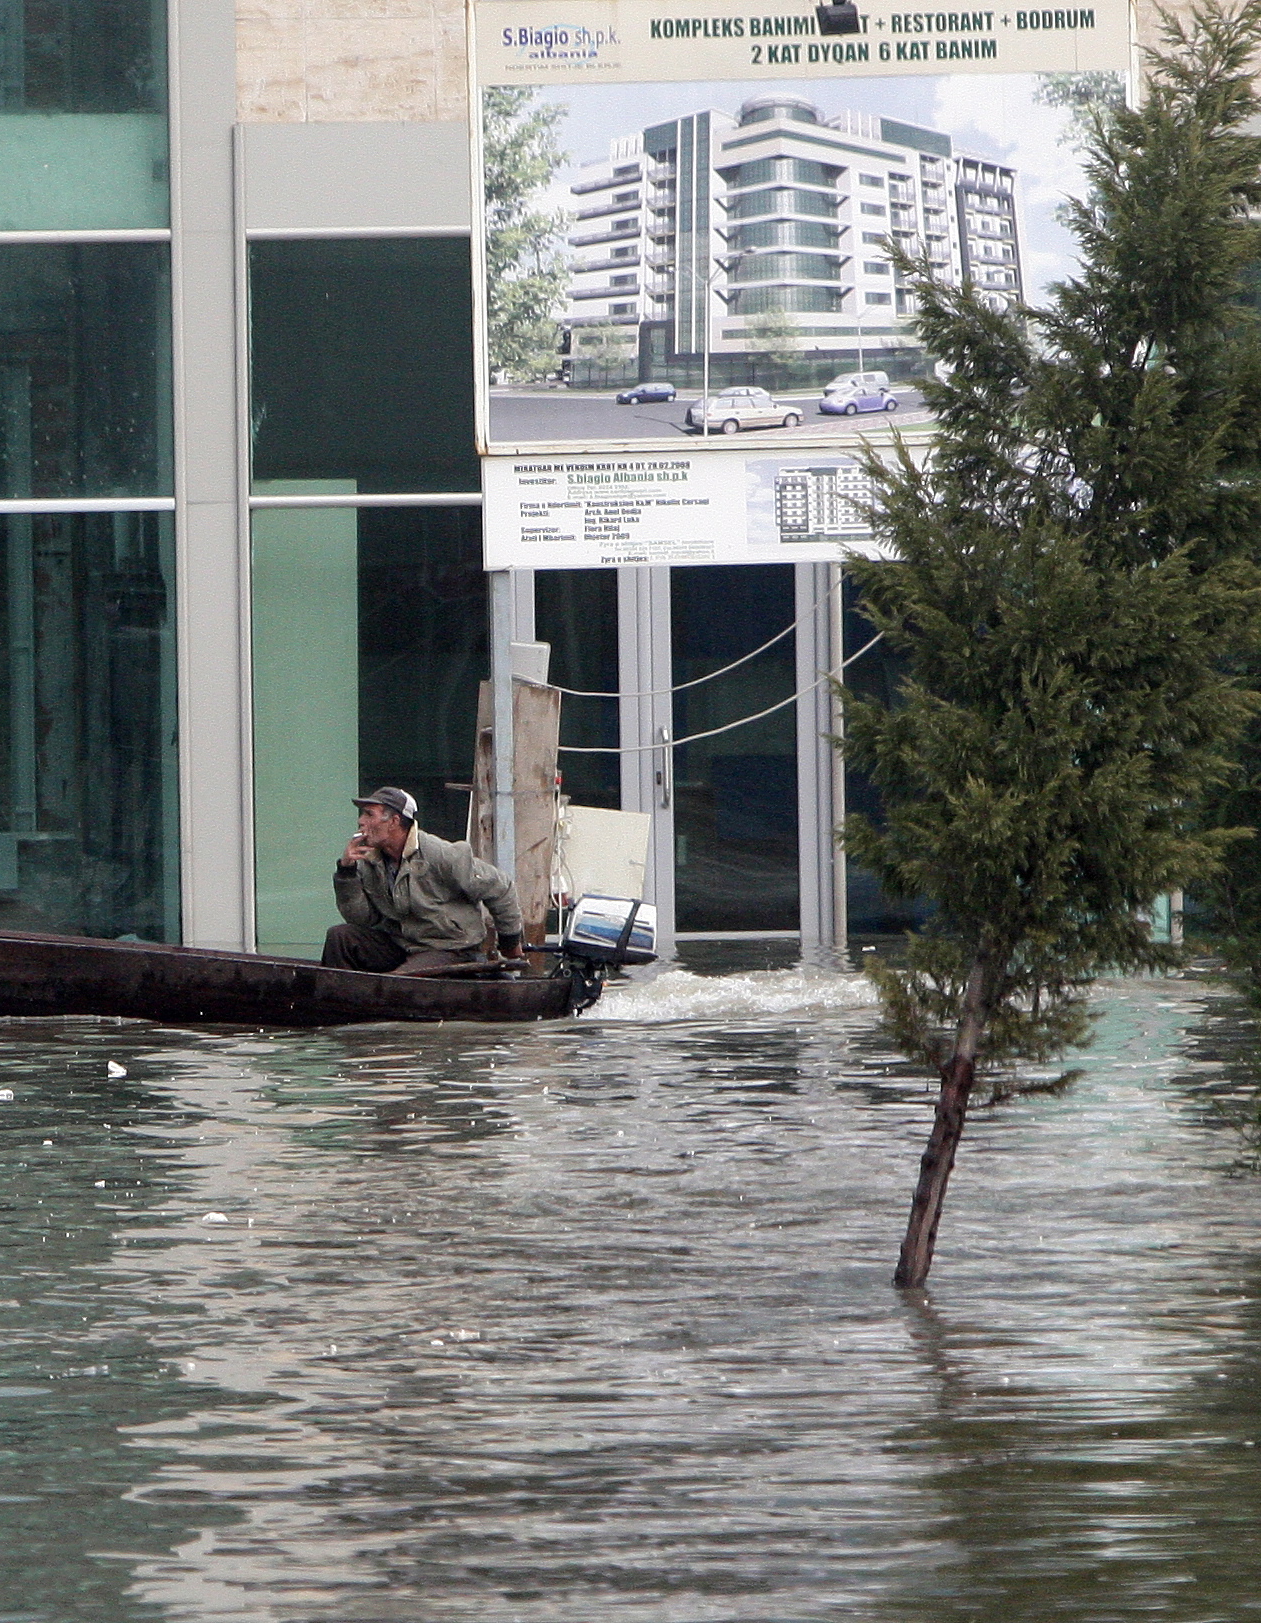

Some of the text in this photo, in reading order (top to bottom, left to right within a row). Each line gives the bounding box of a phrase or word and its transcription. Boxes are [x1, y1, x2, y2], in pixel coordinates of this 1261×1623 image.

[650, 18, 744, 38] KOMPLEKS
[875, 18, 885, 30] +
[892, 12, 994, 33] RESTORANT
[1001, 15, 1011, 27] +
[1017, 9, 1095, 30] BODRUM
[502, 25, 621, 50] S.Biagio sh.p.k.
[751, 39, 997, 64] 2 KAT DYQAN 6 KAT BANIM
